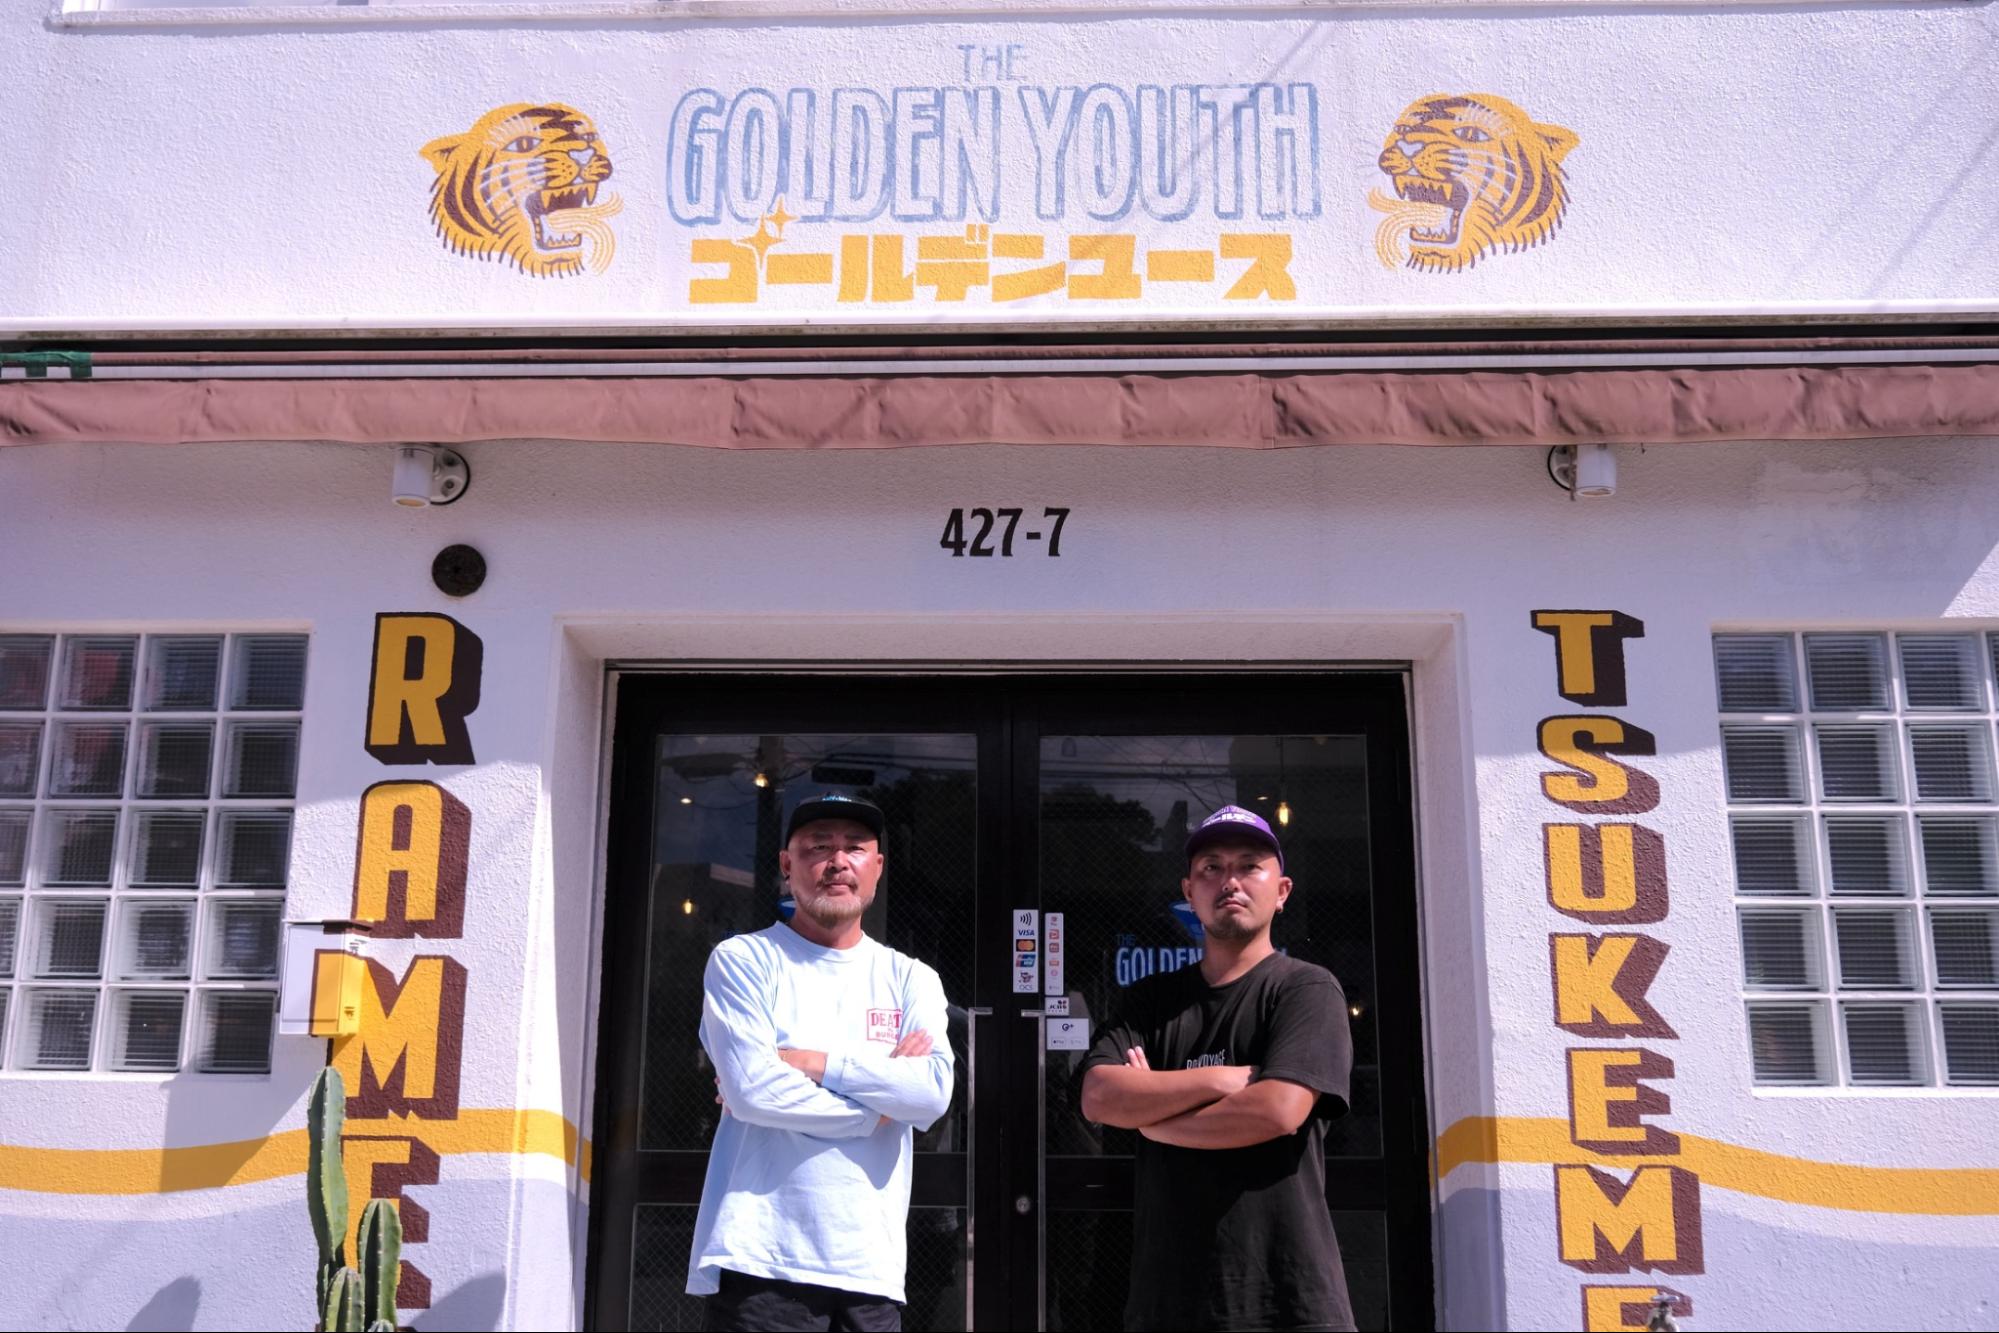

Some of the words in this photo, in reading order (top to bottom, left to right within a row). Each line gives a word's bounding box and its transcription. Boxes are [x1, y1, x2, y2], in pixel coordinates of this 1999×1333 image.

[957, 44, 1028, 82] THE
[667, 85, 1000, 226] GOLDEN
[1017, 82, 1323, 224] YOUTH
[689, 224, 1297, 305] ゴールデンユース
[940, 507, 1070, 557] 427-7
[309, 612, 483, 1332] RAME
